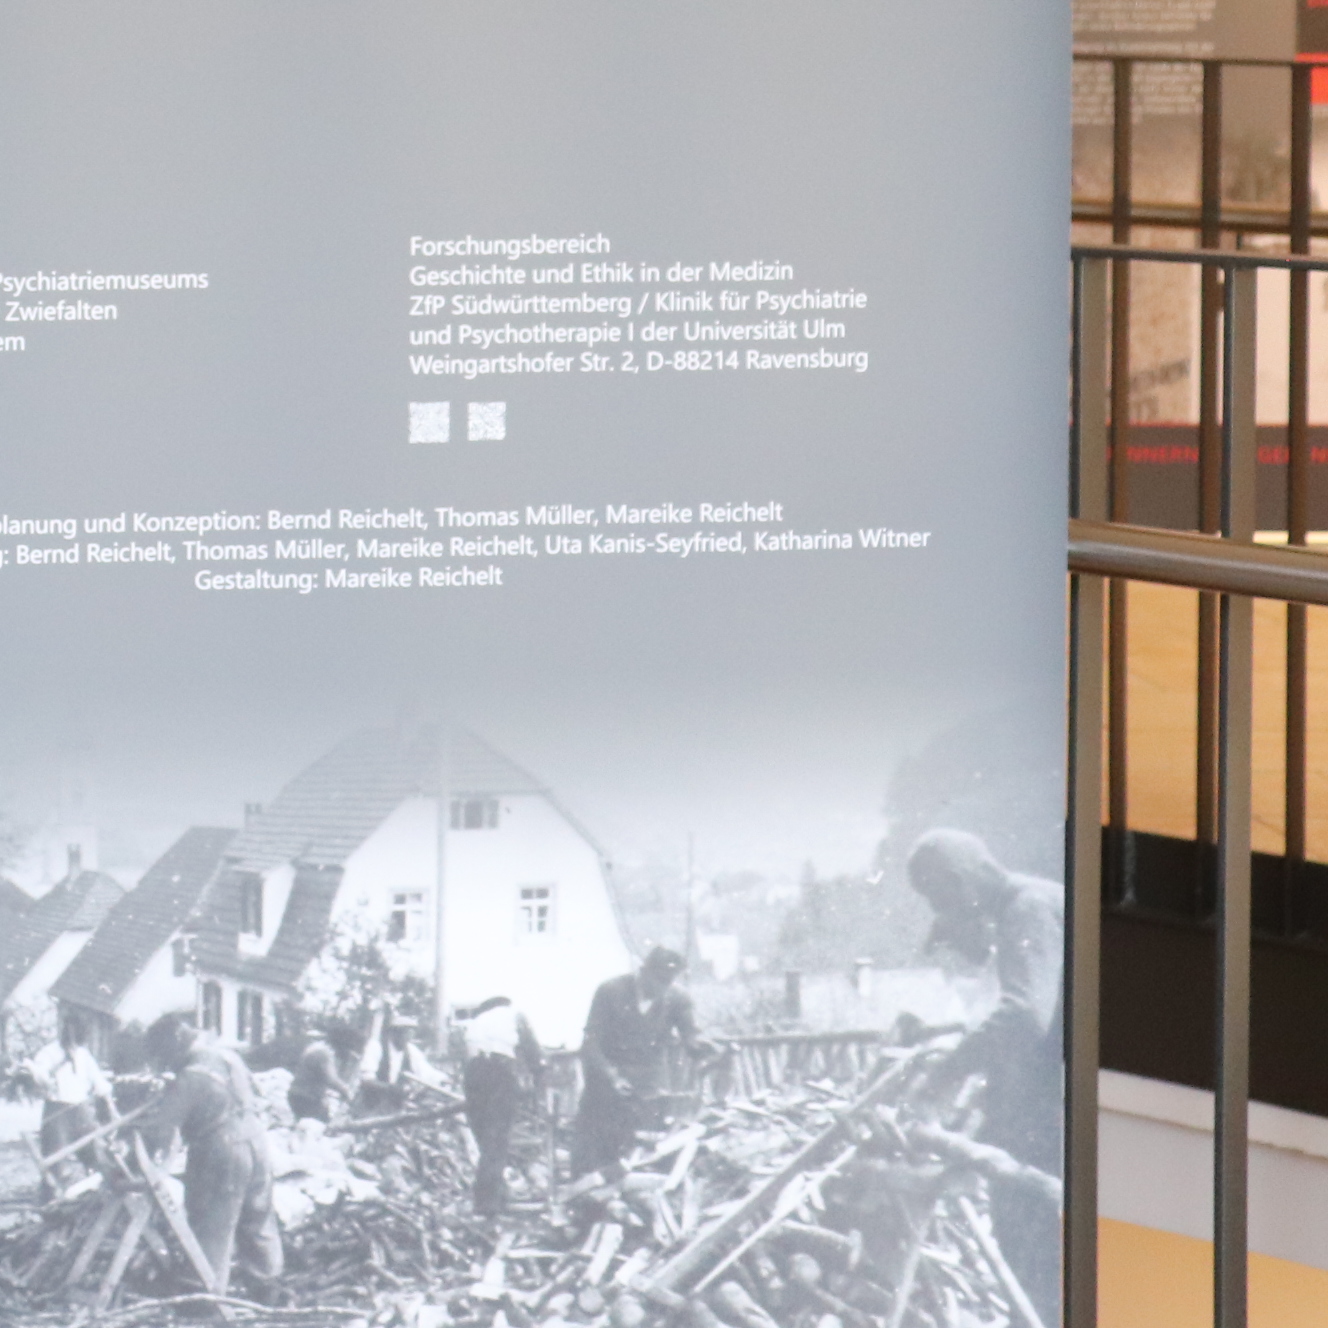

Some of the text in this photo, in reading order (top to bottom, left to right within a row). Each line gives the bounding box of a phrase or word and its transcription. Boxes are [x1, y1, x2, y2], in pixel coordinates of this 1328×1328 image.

[409, 231, 611, 261] Forschungsbereich
[408, 258, 794, 287] Geschichte und Ethik in der Medizin
[4, 298, 119, 322] Zwiefalten
[408, 287, 868, 319] ZfP Südwürttemberg / Klinik für Psychiatrie
[408, 323, 452, 346] und
[458, 321, 622, 350] Psychotherapie
[639, 320, 679, 342] der
[683, 319, 798, 342] Universität
[801, 317, 847, 340] Ulm
[408, 346, 869, 380] Weingartshofer Str. 2, D-88214 Ravensburg
[83, 511, 127, 534] und
[132, 509, 261, 537] Konzeption:
[267, 507, 332, 531] Bernd
[338, 506, 429, 531] Reichelt,
[433, 505, 520, 528] Thomas
[525, 503, 600, 528] Müller,
[605, 501, 693, 525] Mareike
[698, 500, 784, 523] Reichelt
[15, 542, 80, 565] Bernd
[86, 540, 177, 565] Reichelt,
[181, 539, 269, 561] Thomas
[274, 537, 350, 562] Müller,
[356, 536, 445, 559] Mareike
[449, 533, 539, 558] Reichelt,
[544, 534, 583, 555] Uta
[588, 530, 748, 558] Kanis-Seyfried,
[753, 528, 854, 552] Katharina
[857, 526, 932, 549] Witner
[194, 564, 504, 595] Gestaltung: Mareike Reichelt
